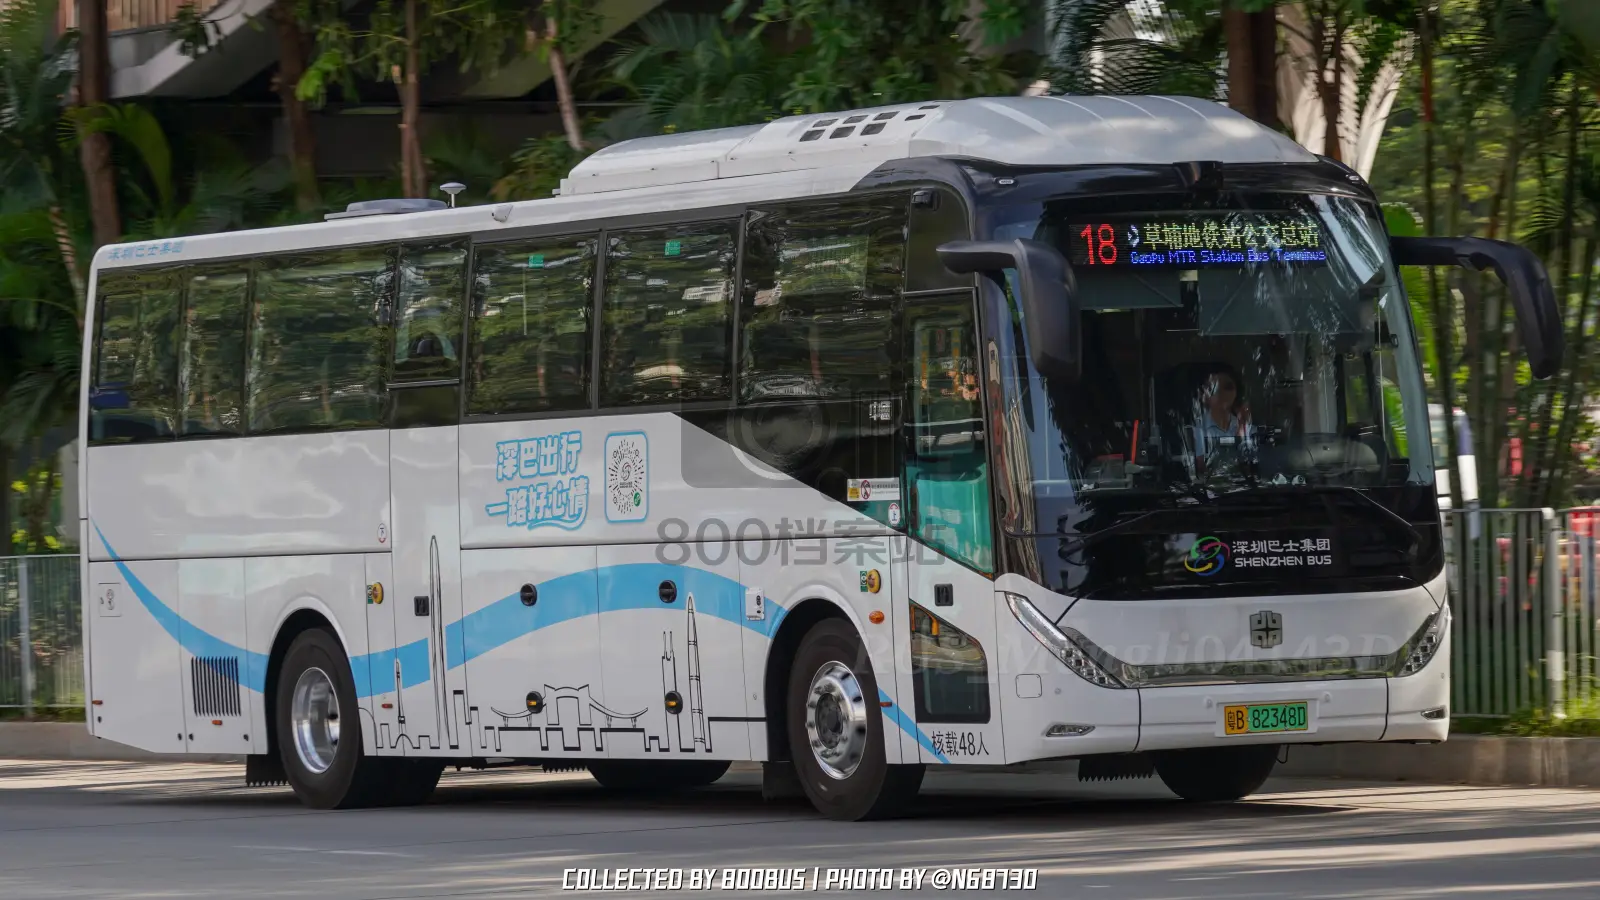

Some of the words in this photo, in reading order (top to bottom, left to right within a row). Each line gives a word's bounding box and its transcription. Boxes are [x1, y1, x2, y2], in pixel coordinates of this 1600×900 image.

[1080, 223, 1117, 265] 18
[1143, 221, 1319, 250] 草埔地铁站公交总站
[1168, 250, 1197, 263] MTR
[1200, 249, 1245, 263] Station
[1247, 249, 1270, 262] Bus
[1273, 248, 1327, 262] Terminus
[496, 430, 582, 482] 深巴出行
[485, 475, 589, 530] 一路好心情
[1232, 538, 1331, 554] 深圳巴士集团
[1234, 555, 1303, 568] SHENZHEN
[1307, 554, 1332, 566] BUS
[1252, 705, 1306, 729] 82348D
[931, 730, 990, 756] 核载48人
